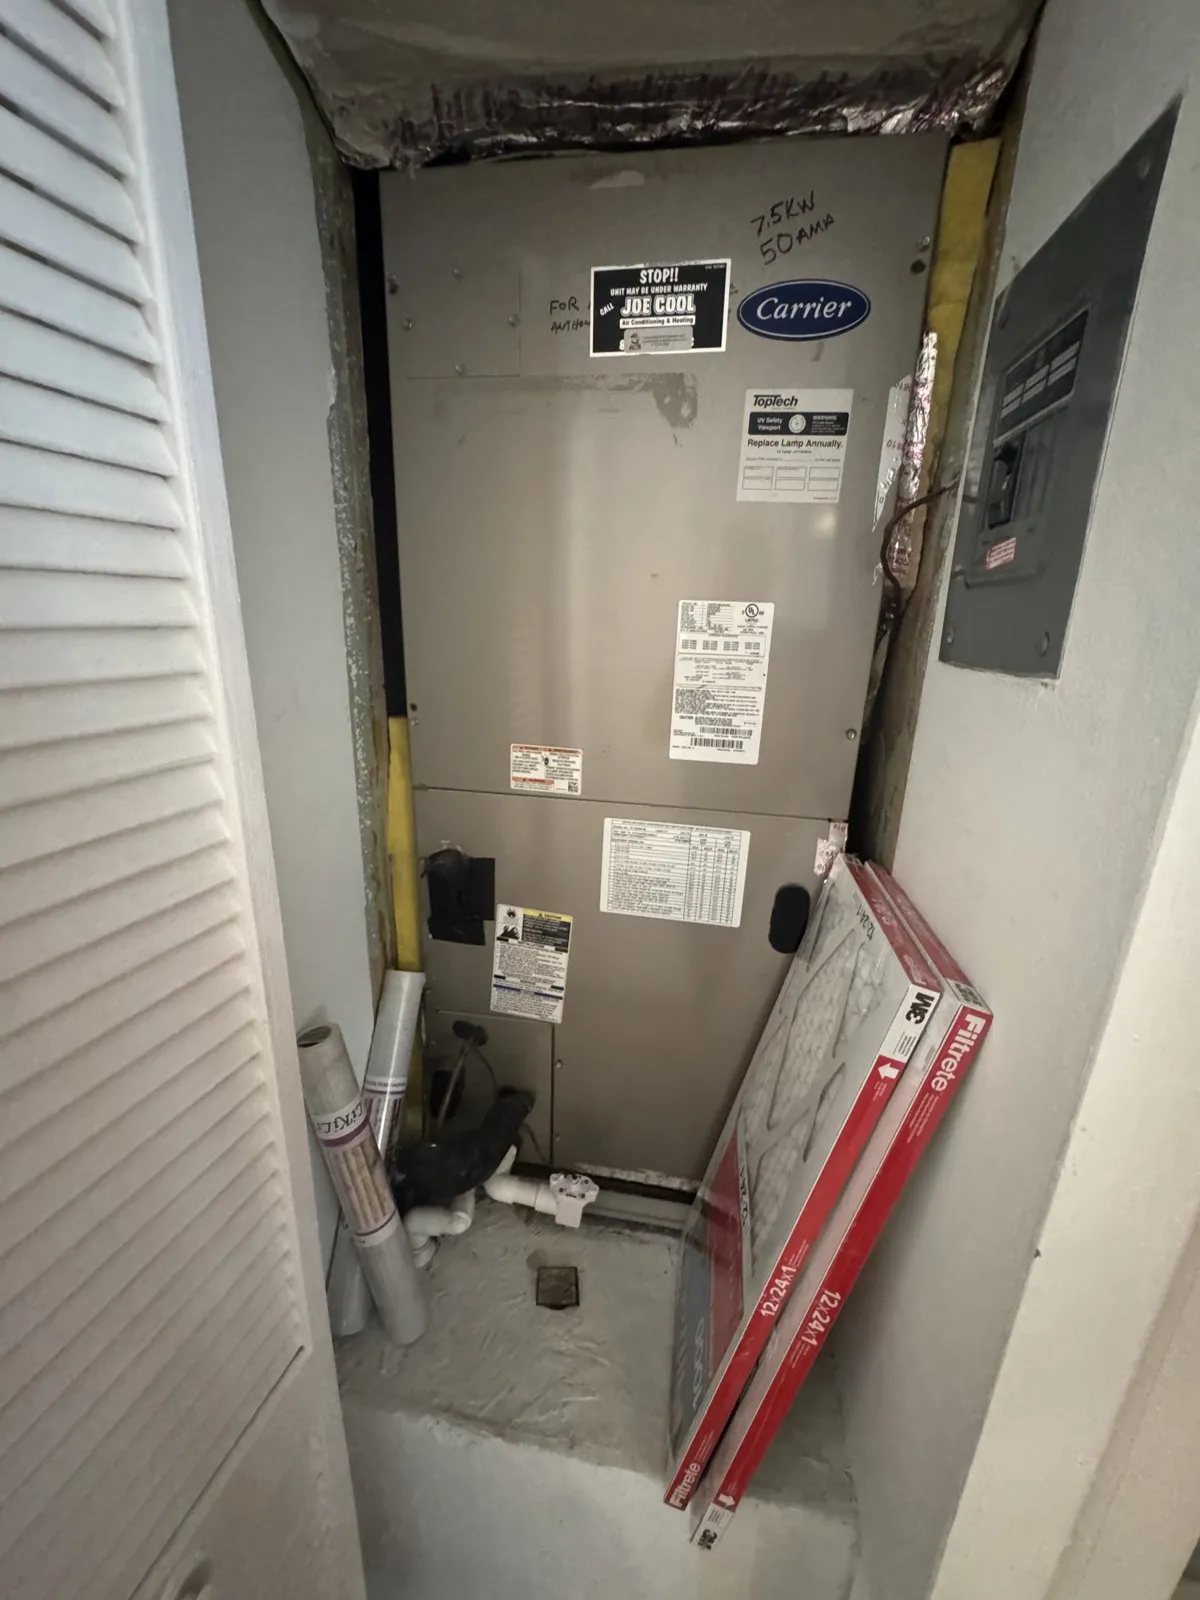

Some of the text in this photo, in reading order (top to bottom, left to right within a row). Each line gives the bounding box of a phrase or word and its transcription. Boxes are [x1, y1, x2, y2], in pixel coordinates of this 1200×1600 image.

[750, 190, 815, 237] 7.5KW
[760, 233, 793, 265] 50
[639, 267, 679, 284] STOP!!
[610, 283, 708, 296] UNIT MAY BE UNDER WARRANTY
[550, 296, 579, 316] FOR
[599, 302, 615, 316] CALL
[621, 294, 695, 315] JOE COOL
[756, 297, 852, 321] Carrier
[631, 318, 665, 326] Conditioning
[672, 317, 694, 325] Heating
[752, 394, 798, 409] TopTech
[766, 416, 783, 424] Safety
[748, 439, 779, 448] Replace
[781, 439, 804, 448] Lamp
[906, 992, 936, 1024] 3M
[931, 1013, 987, 1092] Filtrete
[761, 1263, 798, 1319] 12x24x1
[801, 1288, 841, 1347] 12x24x1
[669, 1461, 701, 1508] Filtrete
